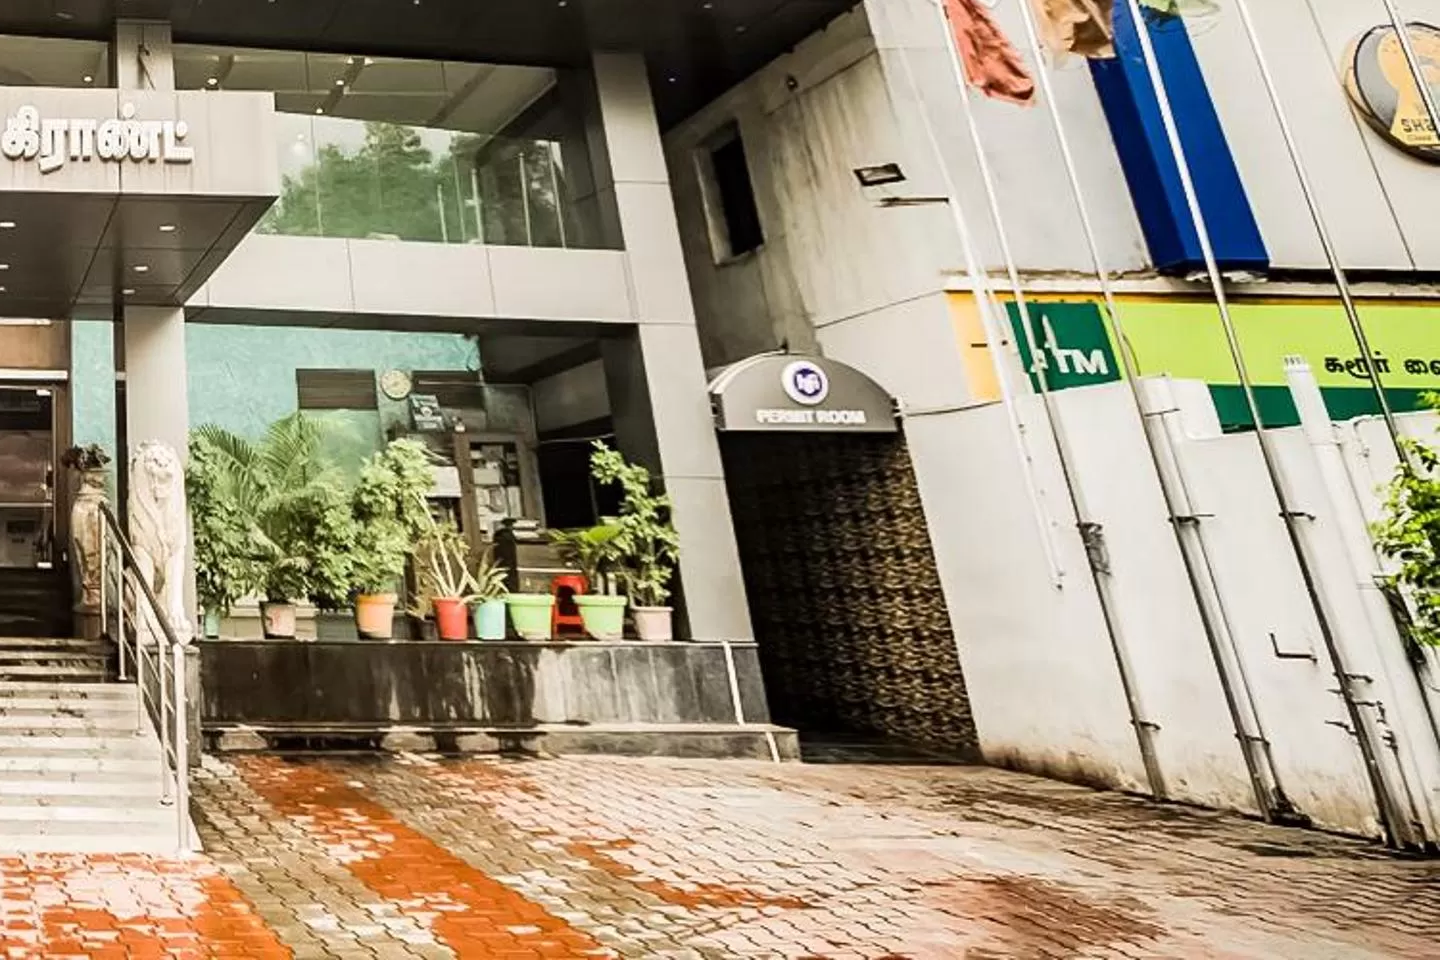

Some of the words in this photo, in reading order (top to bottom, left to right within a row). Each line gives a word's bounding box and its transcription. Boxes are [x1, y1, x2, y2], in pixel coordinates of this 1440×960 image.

[2, 103, 194, 174] கிராண்ட்
[1030, 349, 1109, 375] ATM
[815, 409, 867, 425] ROOM
